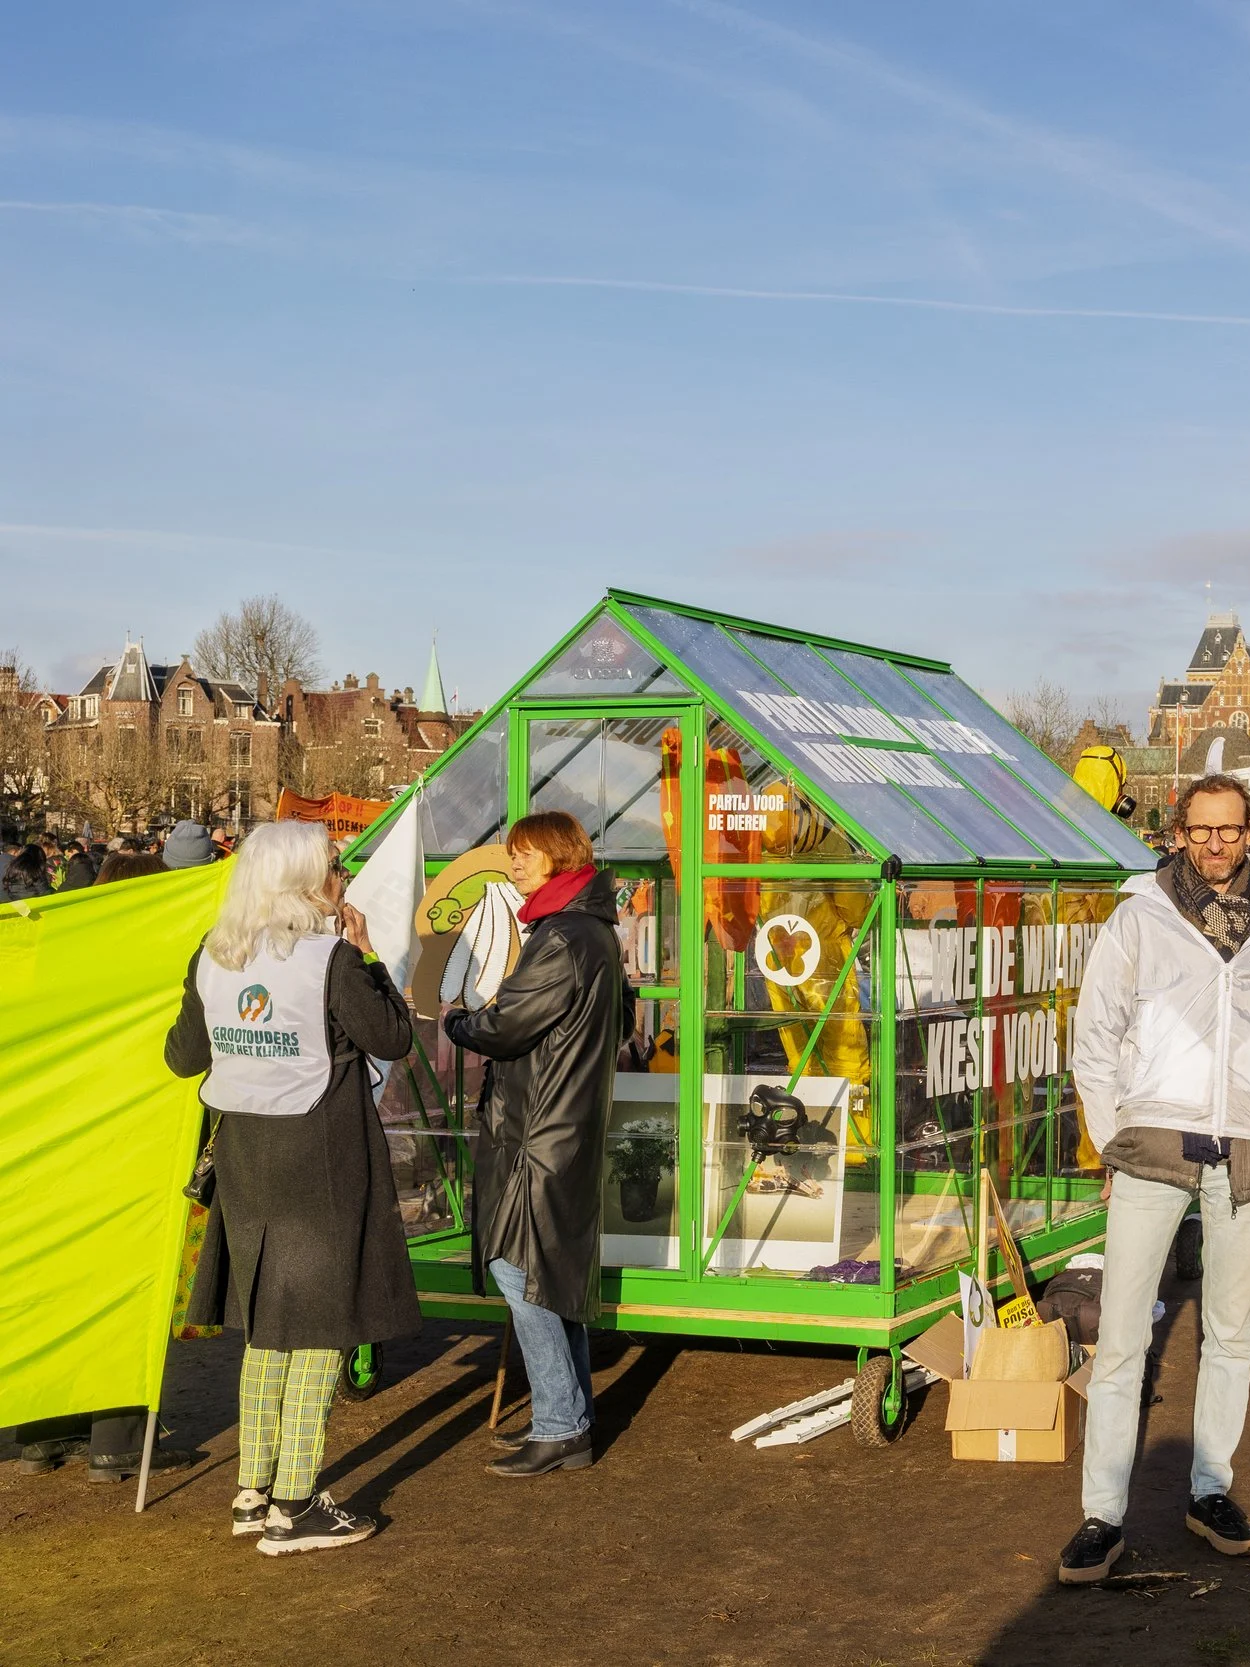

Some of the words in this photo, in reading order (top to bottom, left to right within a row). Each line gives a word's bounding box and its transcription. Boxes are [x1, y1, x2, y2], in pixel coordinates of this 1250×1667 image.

[735, 690, 855, 737] PARTIJ
[824, 702, 917, 743] VOOR
[891, 713, 950, 751] DE
[709, 794, 750, 811] PARTIJ
[753, 794, 784, 811] VOOR
[708, 814, 724, 831] DE
[726, 814, 767, 831] DIEREN
[930, 926, 977, 1003] WIE
[981, 925, 1015, 998] DE
[1021, 923, 1105, 994] WAARH
[212, 1026, 299, 1046] GROOTOUDERS
[214, 1042, 235, 1055] VOOR
[237, 1045, 253, 1056] HET
[255, 1046, 300, 1057] KLIMAAT
[926, 1015, 997, 1099] KIEST
[1003, 1008, 1058, 1084] VOOR
[1003, 1307, 1035, 1328] POISO
